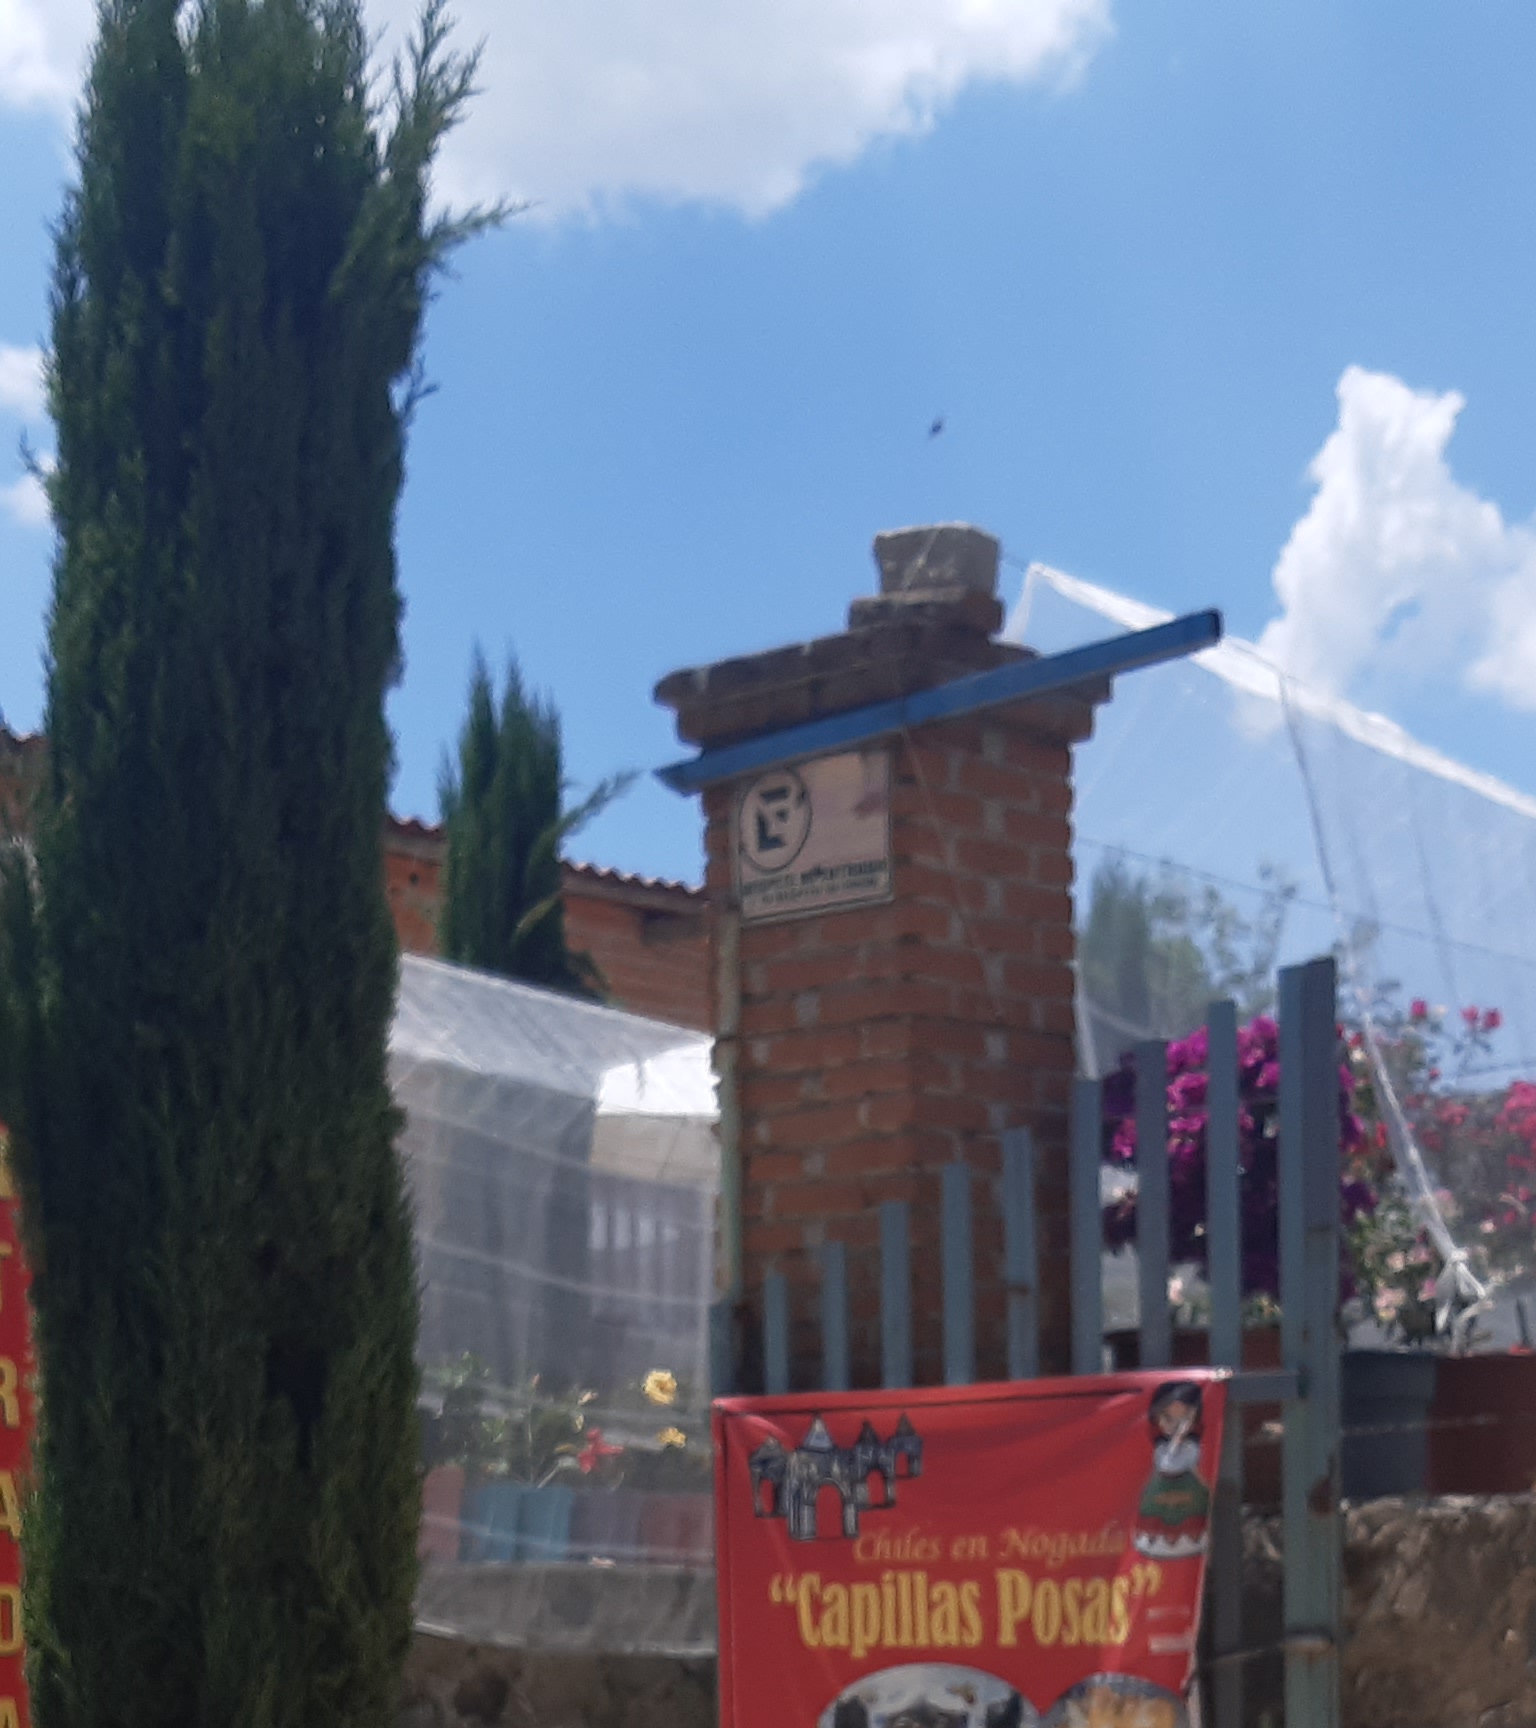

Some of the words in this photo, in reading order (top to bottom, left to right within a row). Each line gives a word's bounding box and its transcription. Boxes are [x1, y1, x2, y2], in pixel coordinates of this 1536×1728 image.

[852, 1526, 941, 1562] Chiles
[950, 1535, 989, 1561] en
[999, 1520, 1125, 1569] Nogada
[770, 1570, 983, 1657] “Capillas
[996, 1561, 1163, 1647] Posas”
